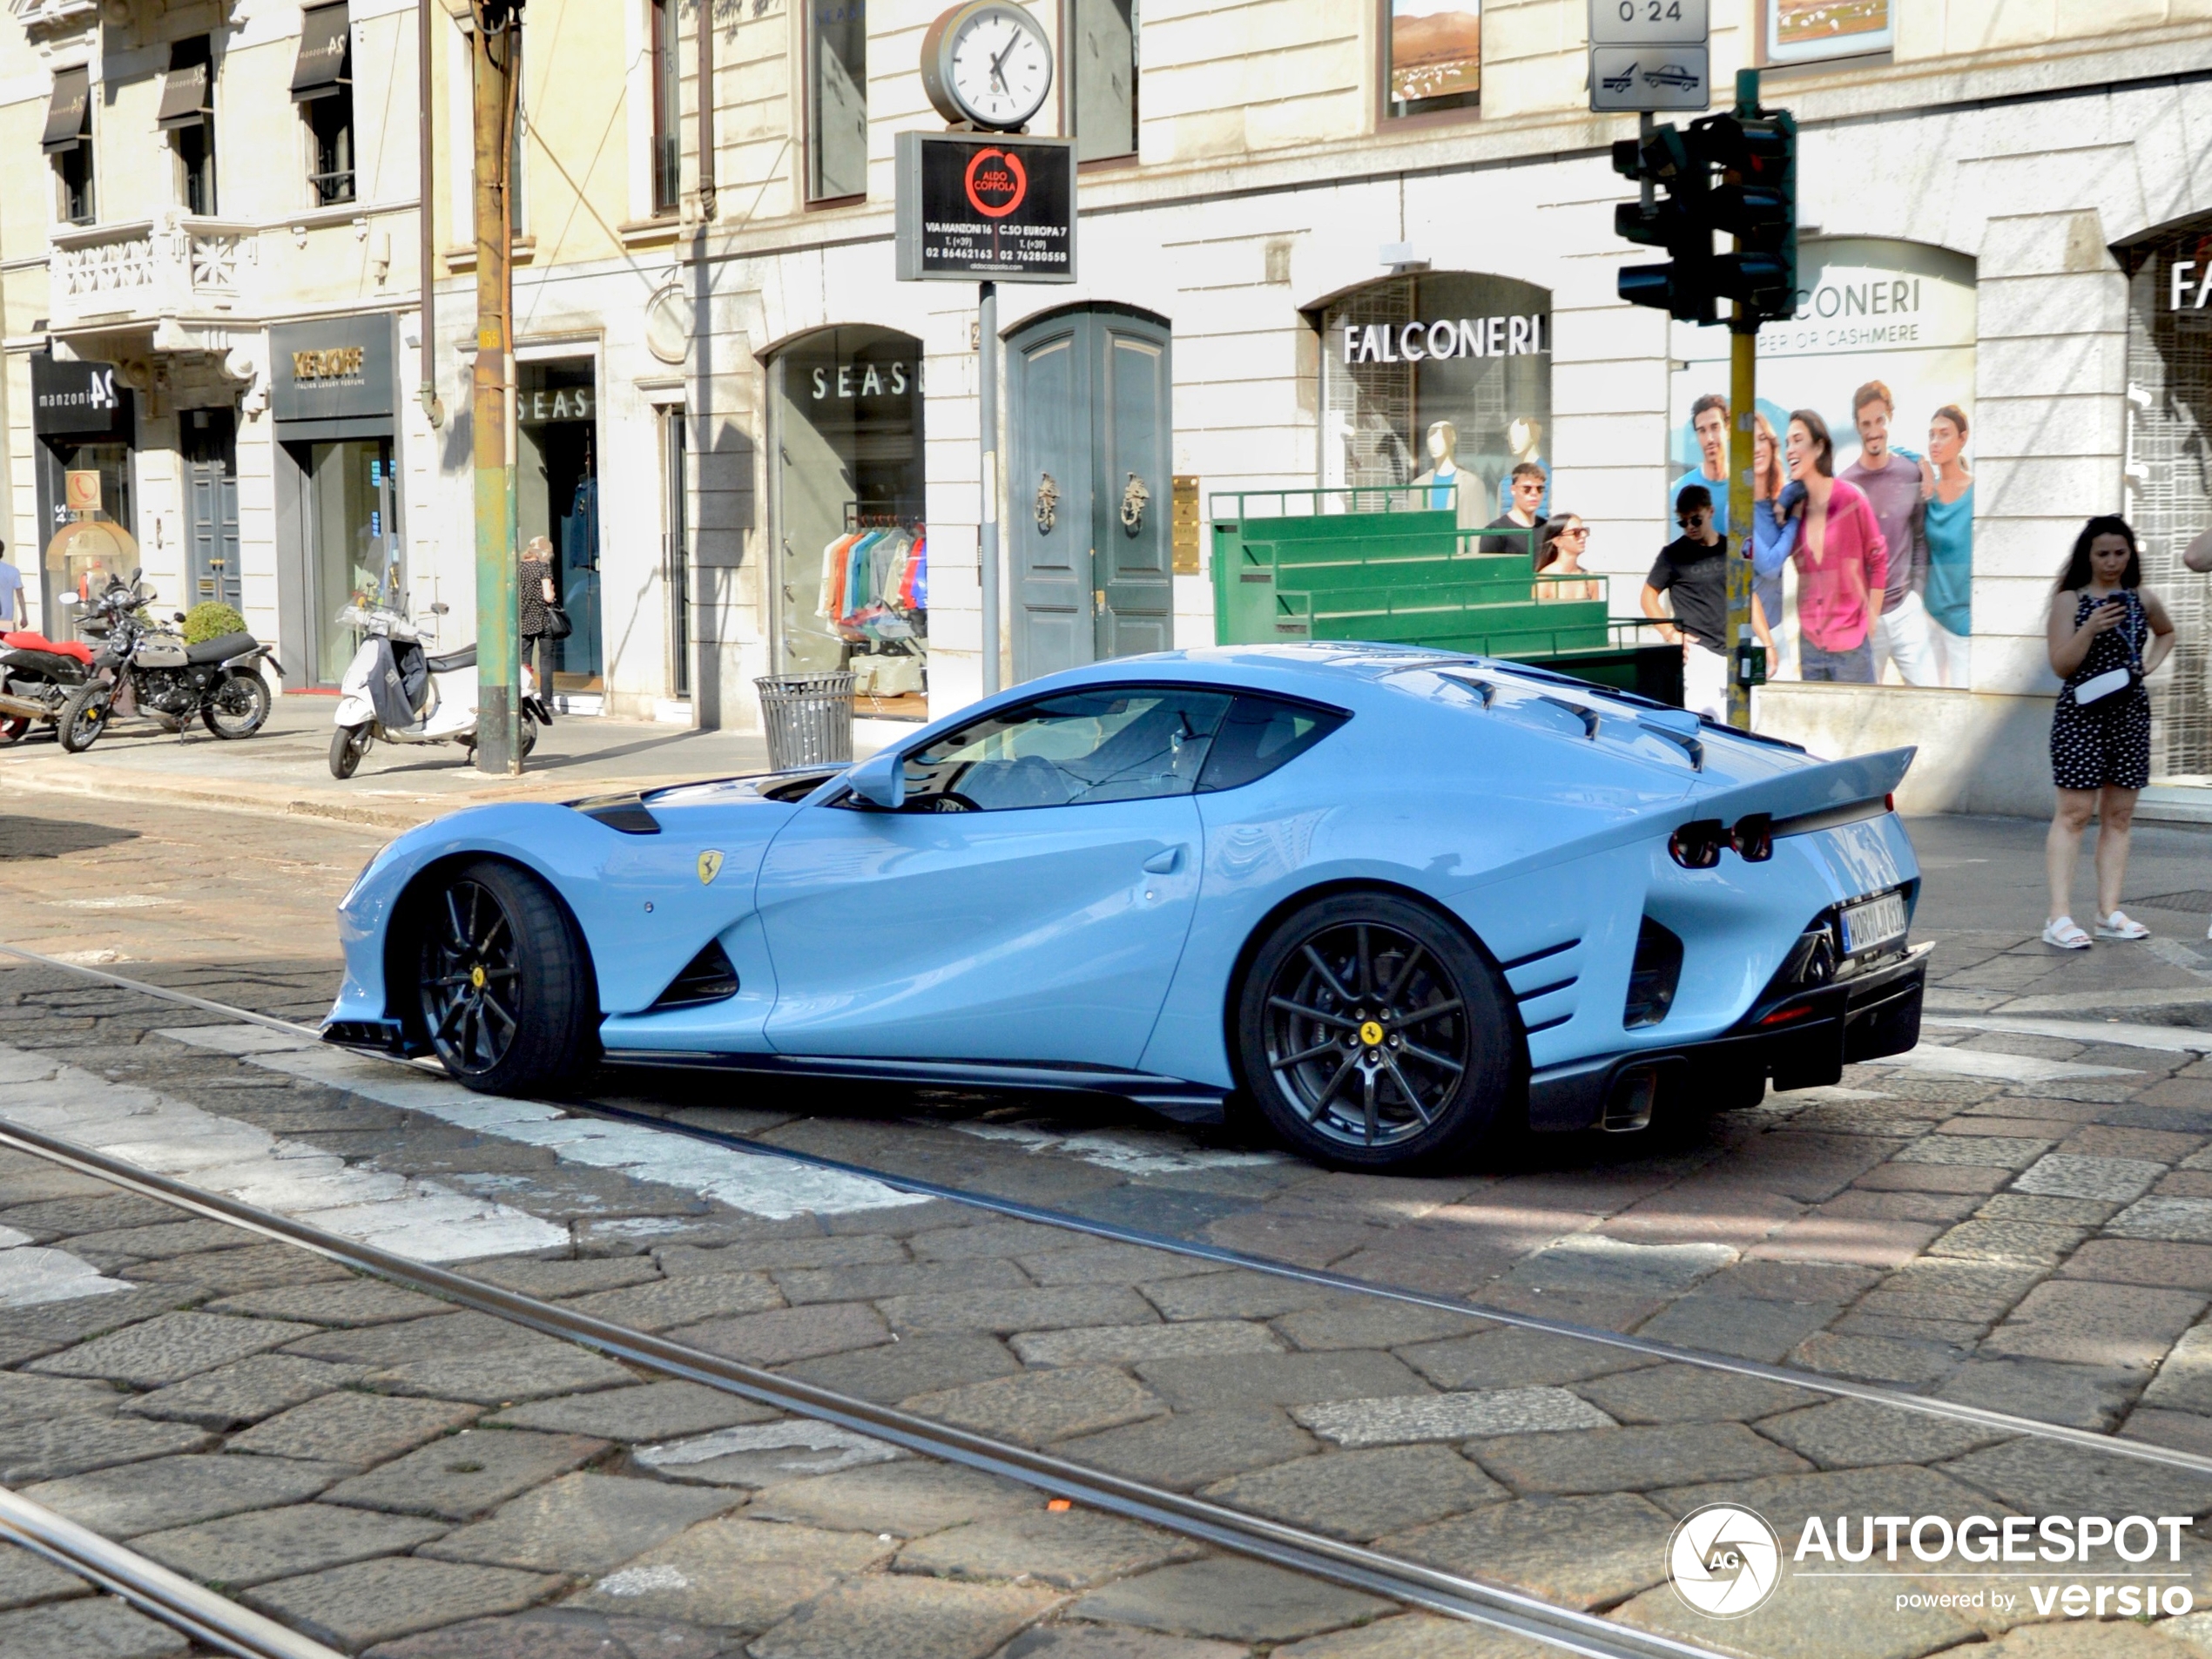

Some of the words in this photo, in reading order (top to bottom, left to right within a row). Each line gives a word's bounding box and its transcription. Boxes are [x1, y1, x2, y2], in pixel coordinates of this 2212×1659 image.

[982, 171, 1007, 182] ALDO
[974, 180, 1016, 192] COPPOLA
[926, 223, 941, 233] VIA
[941, 223, 981, 234] MANZONI
[981, 225, 992, 235] 16
[999, 226, 1022, 236] C.SO
[1023, 226, 1059, 237] EUROPA
[1060, 227, 1067, 237] 7
[945, 237, 951, 246] T.
[953, 237, 973, 247] (+39)
[1027, 239, 1047, 250] (+39)
[926, 247, 939, 258] 02
[942, 248, 993, 260] 86462163
[1000, 251, 1013, 260] 02
[1016, 251, 1067, 262] 76280558
[970, 262, 1023, 271] aldocoppola.com
[1344, 314, 1541, 364] FALCONERI
[1826, 324, 1919, 346] CASHMERE
[39, 389, 90, 407] manzoni
